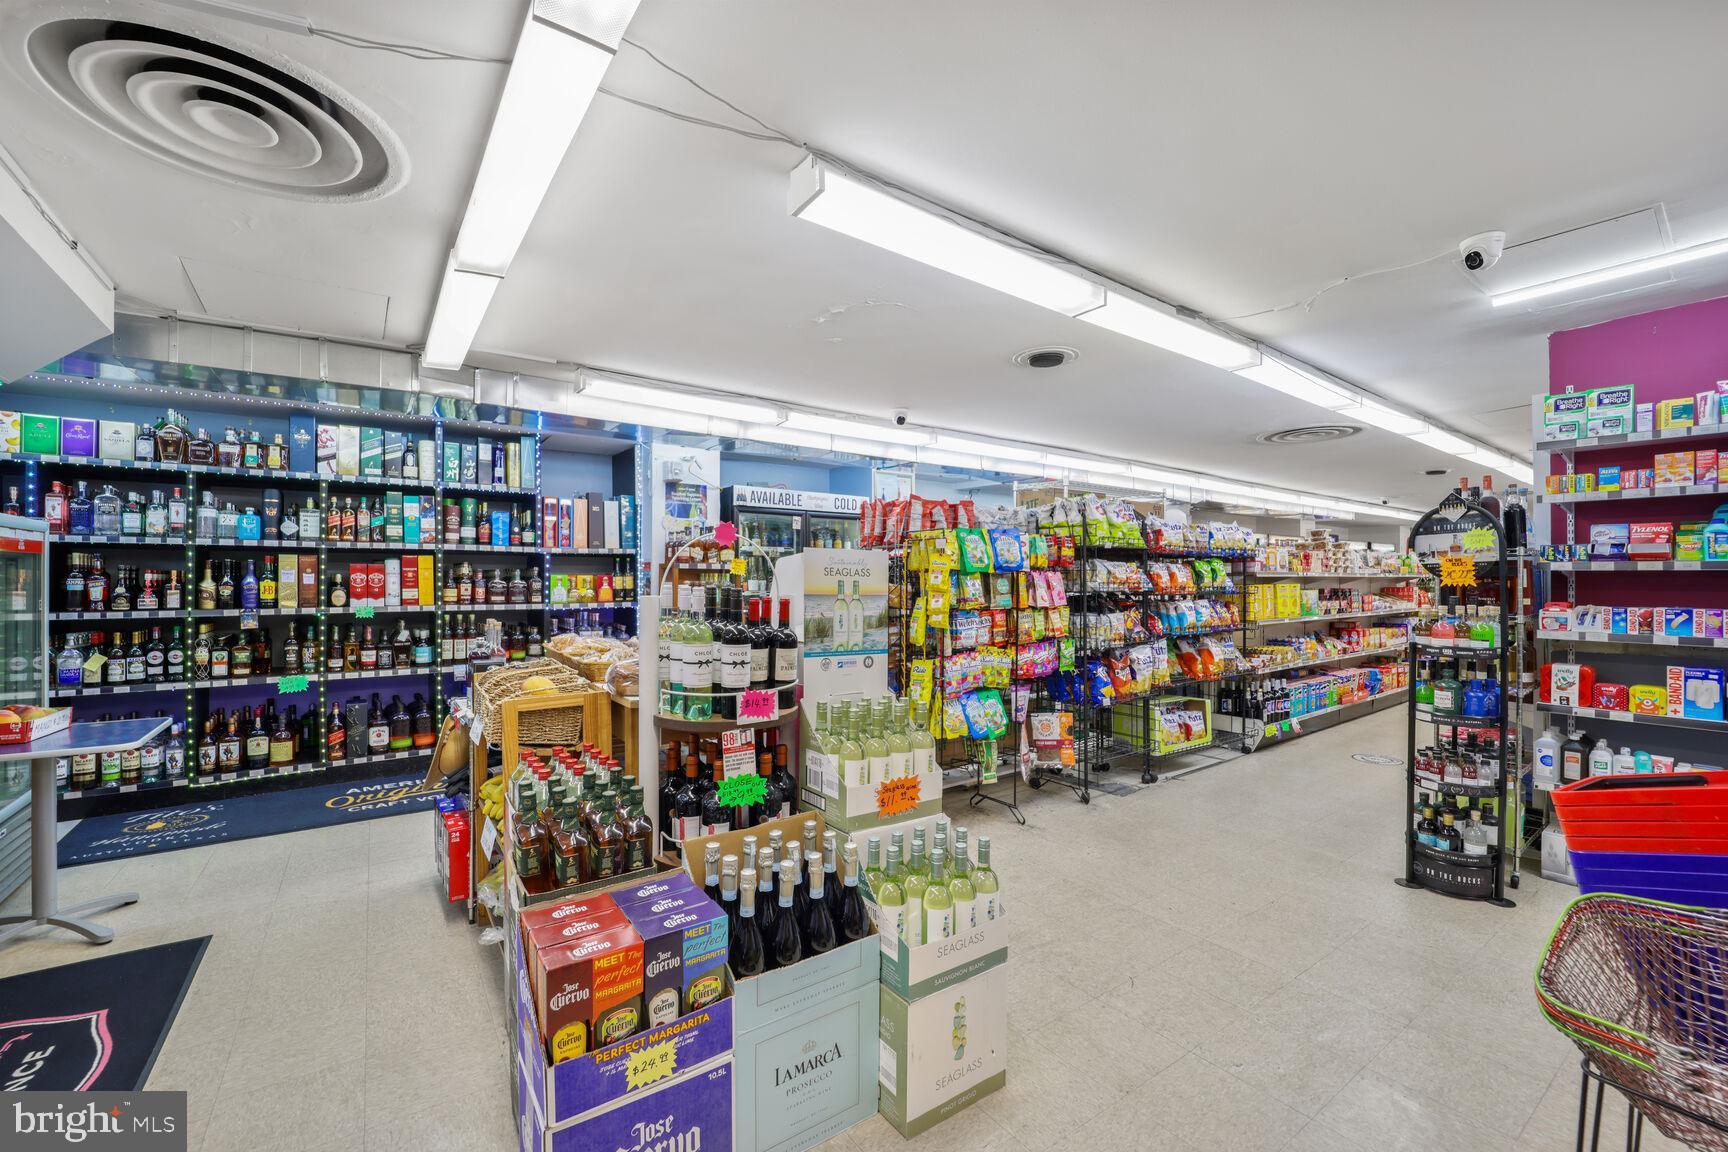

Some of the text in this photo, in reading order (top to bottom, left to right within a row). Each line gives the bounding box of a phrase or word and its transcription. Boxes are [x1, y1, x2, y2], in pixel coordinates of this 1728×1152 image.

[750, 490, 857, 510] AVAILABLE COLD
[824, 567, 871, 578] SEAGLASS
[1668, 668, 1682, 705] BAND-AID
[724, 780, 752, 790] CLOSE
[348, 798, 411, 812] CRAFT
[637, 884, 669, 897] Cuervo
[552, 906, 588, 919] Cuervo
[561, 904, 576, 912] Jose
[651, 899, 684, 912] Cuervo
[572, 920, 587, 928] Jose
[663, 914, 698, 928] Cuervo
[562, 922, 599, 936] Cuervo
[684, 924, 711, 939] MEET
[572, 941, 612, 956] Cuervo
[684, 930, 726, 959] perfect
[936, 930, 984, 958] SEAGLASS
[594, 953, 625, 970] MEET
[656, 950, 672, 962] Jose
[686, 948, 726, 966] MARGARITA
[594, 960, 643, 988] perfect
[646, 956, 680, 978] Cuervo
[934, 961, 985, 986] SAUVIGNON BLANC
[562, 982, 579, 993] Jose
[596, 978, 642, 999] MARGARITA
[550, 988, 590, 1011] Cuervo
[653, 1000, 675, 1014] Cuervo
[557, 1034, 582, 1050] Cuervo
[596, 1038, 646, 1064] PERFECT
[649, 1013, 710, 1043] MARGARITA
[708, 1068, 726, 1080] 10.5L
[935, 1058, 983, 1091] SEAGLASS
[786, 1070, 833, 1096] PROSECCO
[941, 1101, 956, 1114] PINOT
[631, 1114, 674, 1148] Jose
